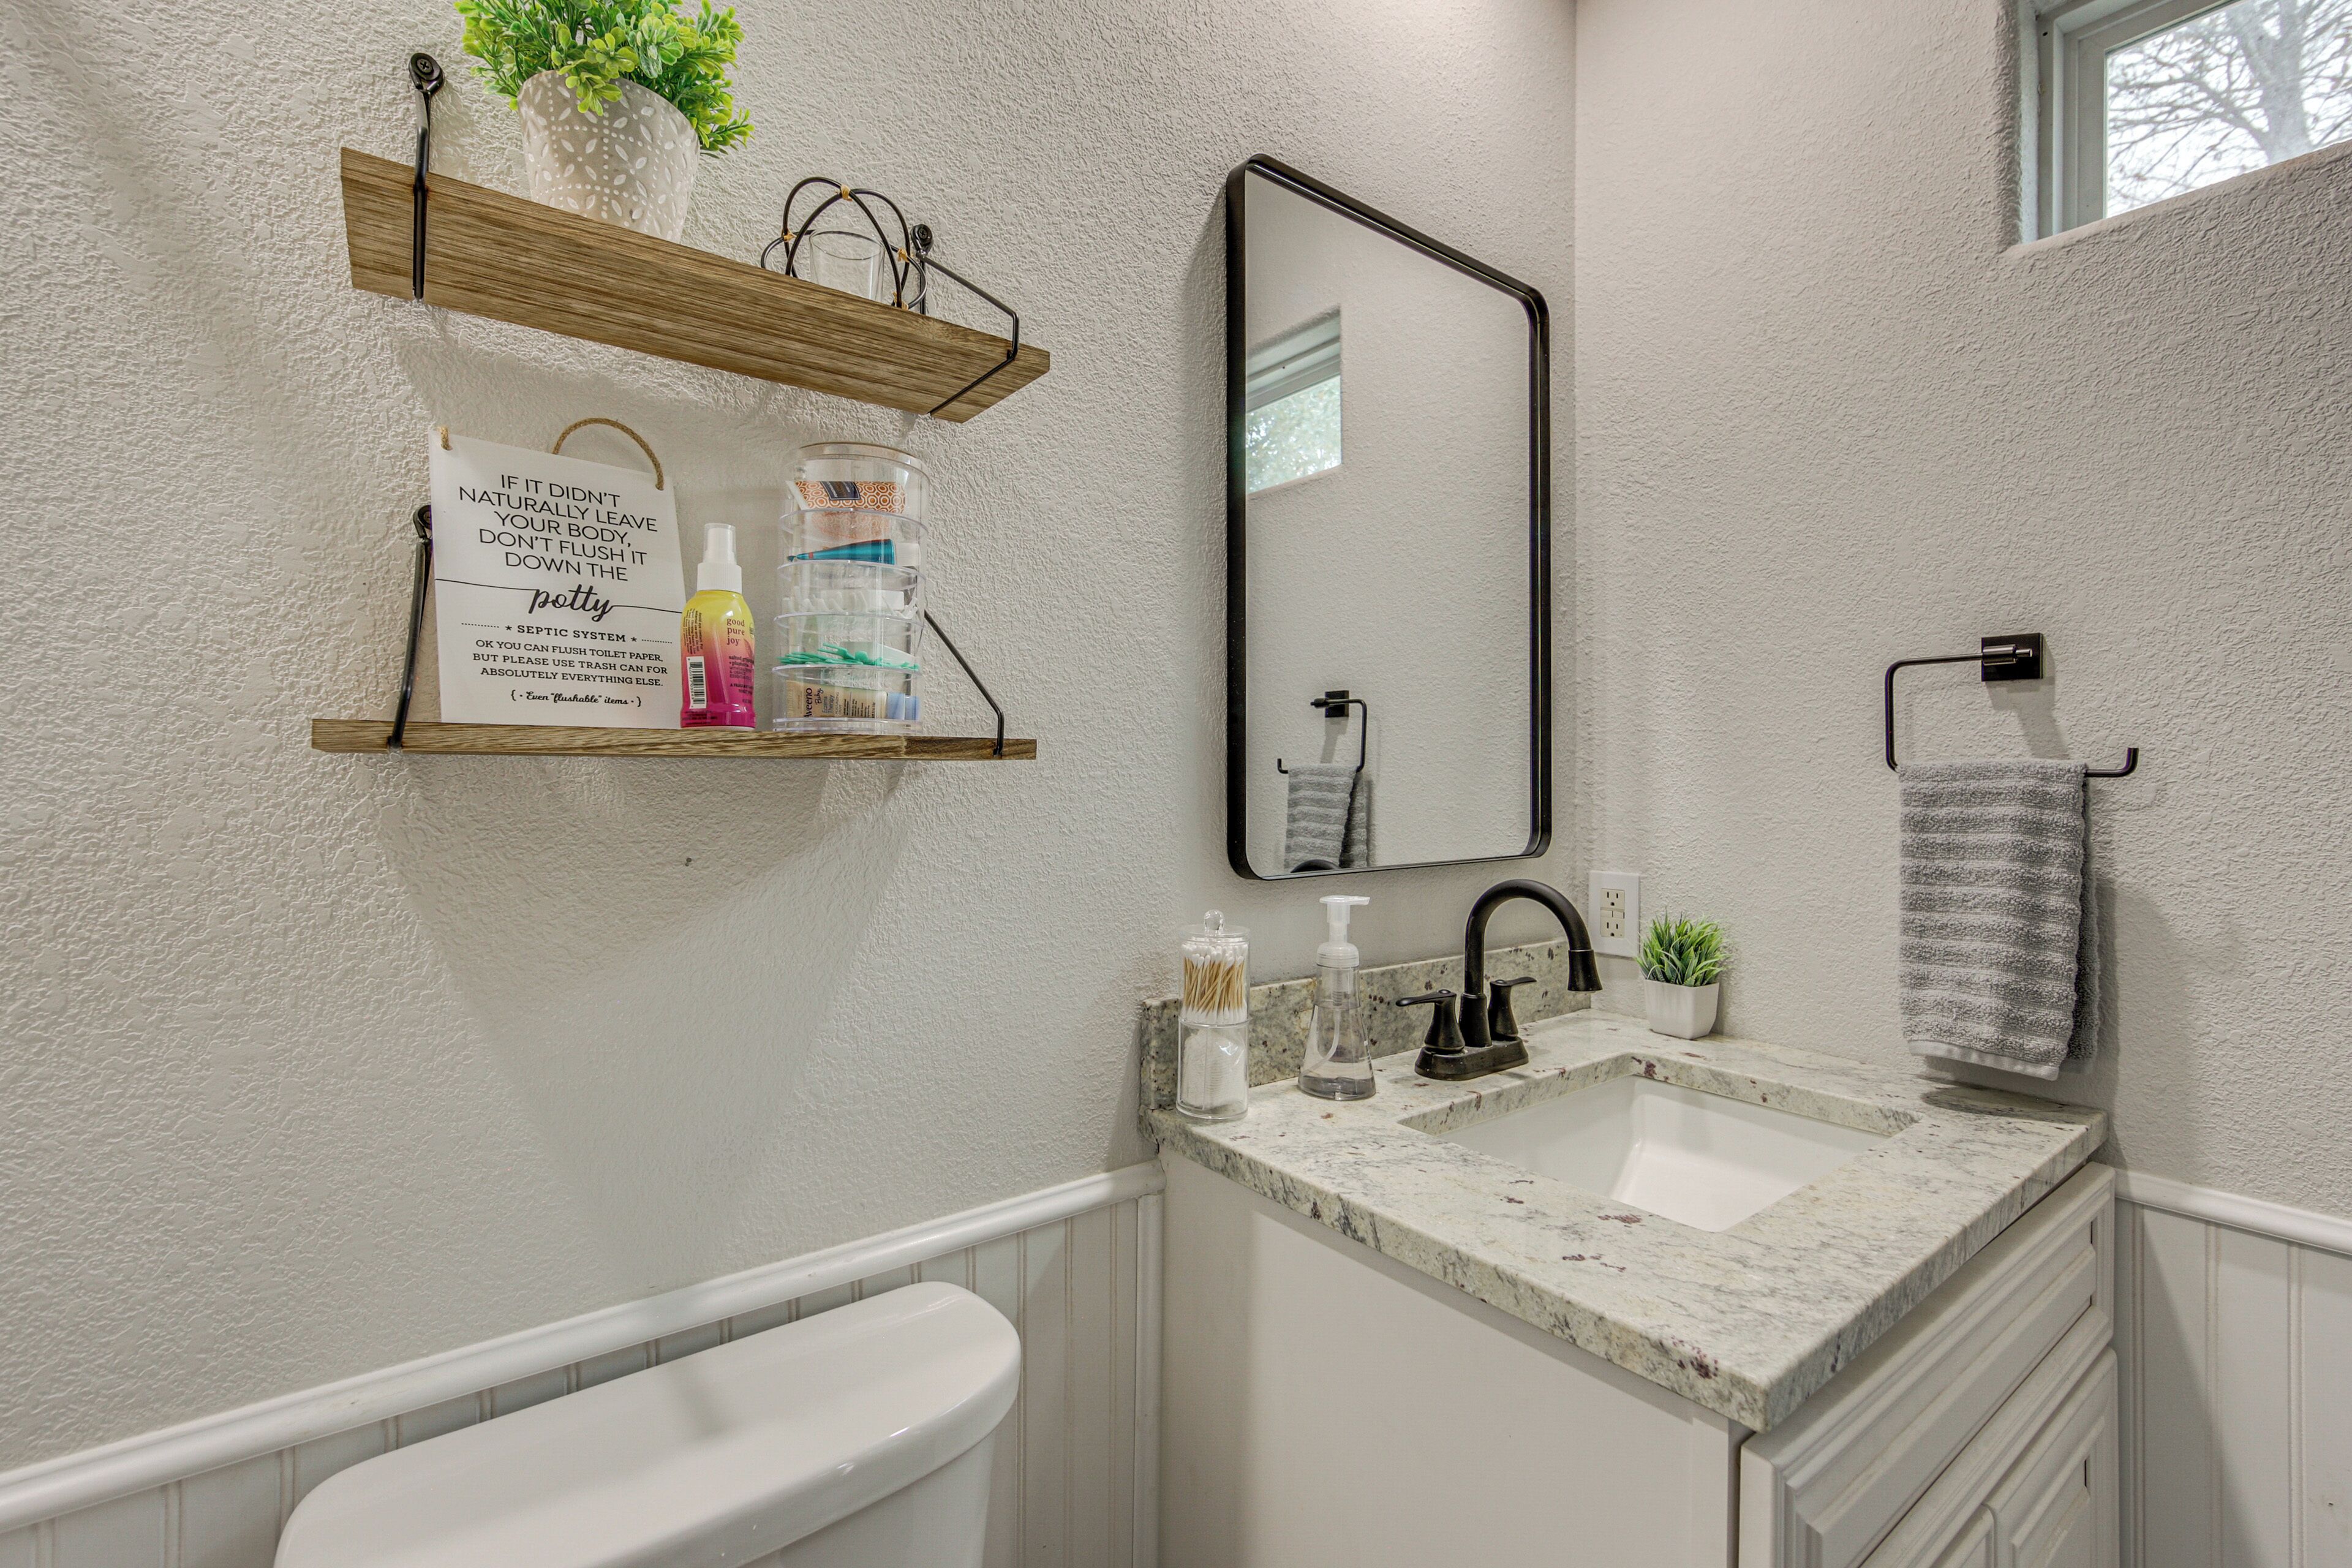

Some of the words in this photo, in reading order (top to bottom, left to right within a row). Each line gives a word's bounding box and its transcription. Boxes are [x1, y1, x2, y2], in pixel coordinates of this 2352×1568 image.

[502, 474, 519, 489] IF
[526, 479, 543, 494] IT
[549, 483, 620, 507] DIDN'T
[459, 486, 589, 520] NATURALLY
[596, 509, 658, 532] LEAVE
[494, 511, 562, 535] YOUR
[568, 523, 631, 547] BODY,
[480, 528, 553, 552] DON'T
[560, 540, 624, 562] FLUSH
[631, 551, 647, 565] IT
[506, 552, 581, 575] DOWN
[586, 562, 628, 581] THE
[528, 584, 613, 622] potty
[727, 618, 745, 627] good
[727, 627, 745, 635] pure
[518, 625, 568, 637] SEPTIC
[573, 630, 626, 642] SYSTEM
[727, 635, 740, 646] joy
[473, 653, 499, 662] BUT
[503, 655, 549, 665] PLEASE
[552, 659, 575, 667] USE
[579, 661, 616, 670] TRASH
[496, 641, 521, 650] YOU
[524, 644, 549, 652] CAN
[552, 646, 587, 655] FLUSH
[590, 649, 627, 658] TOILET
[630, 652, 663, 662] PAPER,
[481, 668, 558, 680] ABSOLUTELY
[562, 673, 633, 684] EVERYTHING
[636, 678, 663, 686] ELSE.
[526, 692, 549, 701] Even
[804, 688, 812, 718] Aveeno
